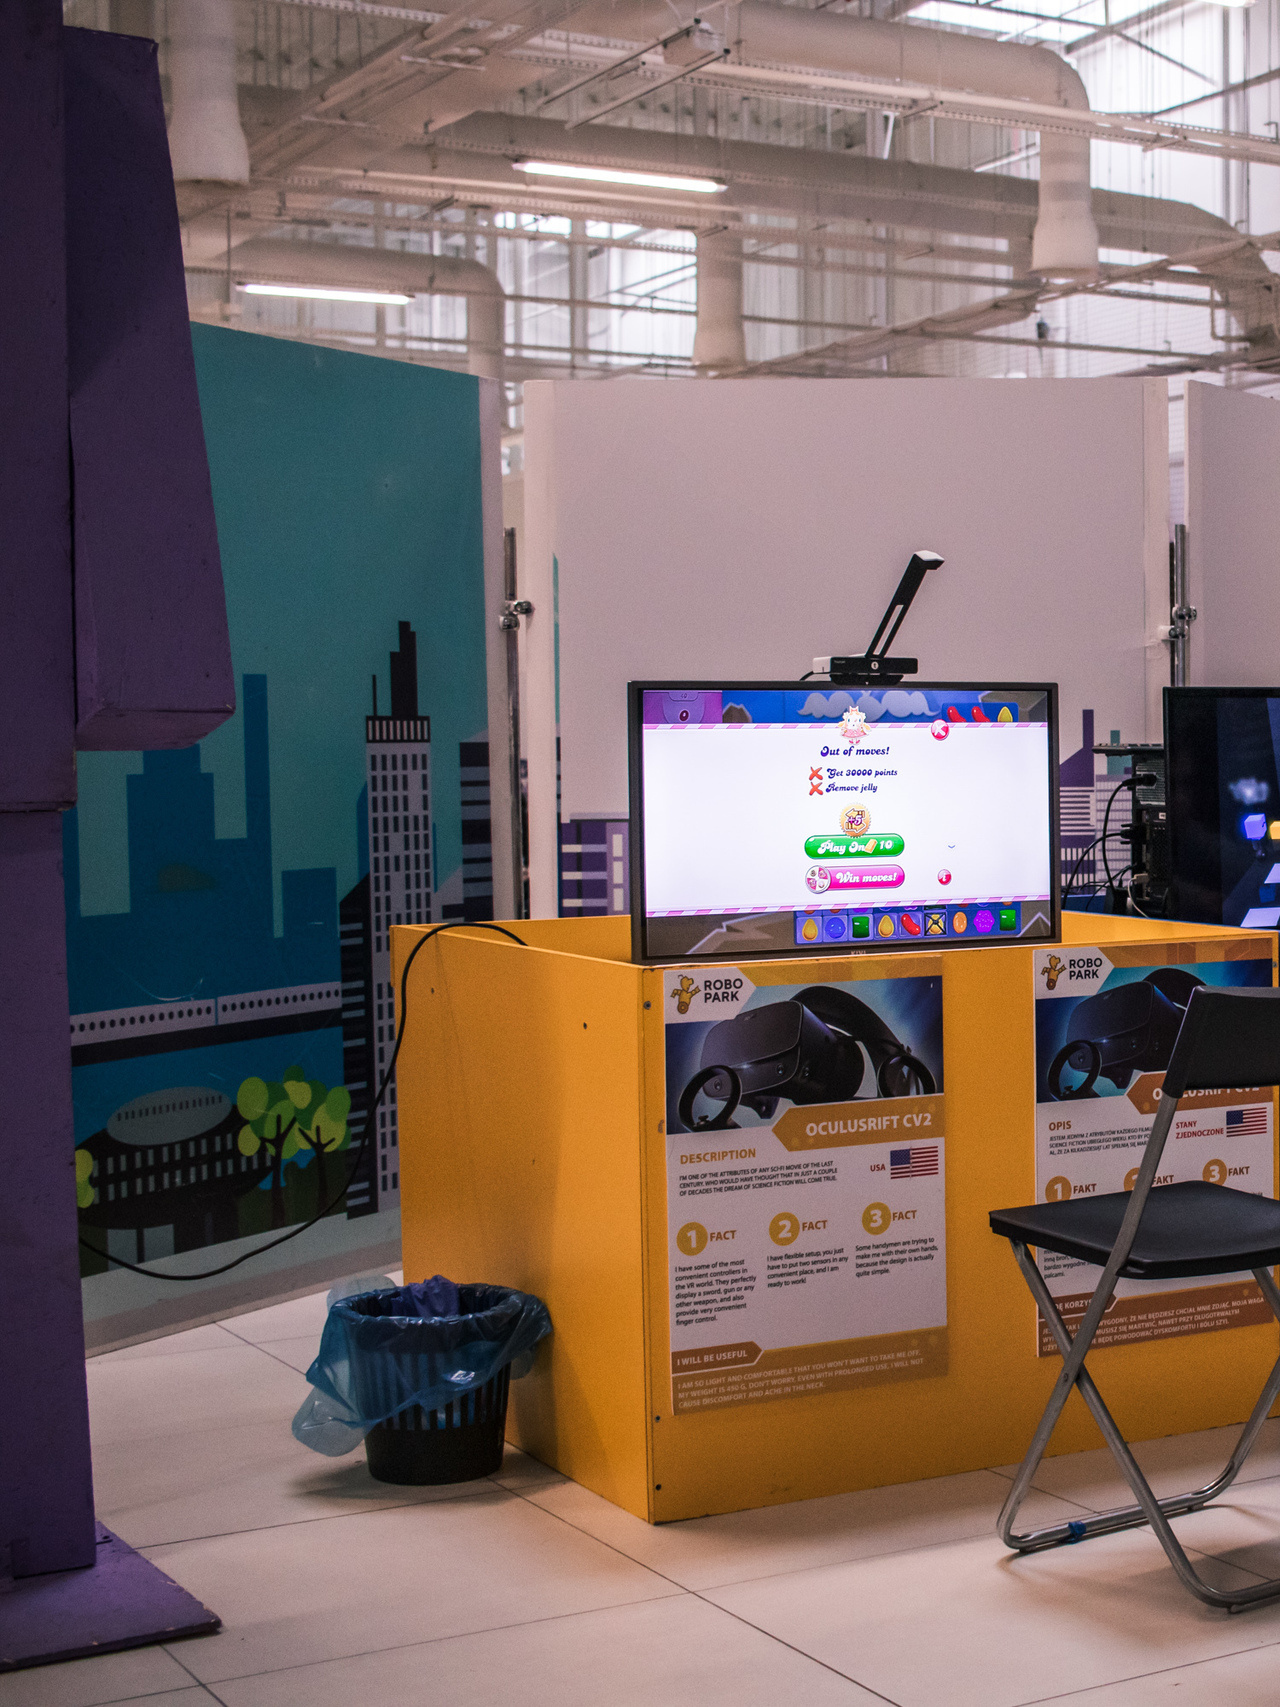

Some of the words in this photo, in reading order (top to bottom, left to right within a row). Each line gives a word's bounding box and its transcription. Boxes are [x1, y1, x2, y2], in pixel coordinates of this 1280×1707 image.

[820, 746, 840, 757] Out
[843, 746, 854, 757] of
[856, 746, 890, 756] moves!
[827, 768, 843, 779] Get
[845, 769, 872, 777] 30000
[874, 768, 898, 778] points
[825, 782, 859, 793] Remove
[860, 783, 878, 793] jelly
[817, 840, 846, 855] Play
[849, 841, 866, 853] On
[879, 840, 893, 850] 10
[835, 871, 860, 884] Win
[862, 872, 897, 883] moves!
[1069, 957, 1103, 969] ROBO
[1069, 968, 1099, 980] PARK
[703, 978, 743, 992] ROBO
[704, 989, 740, 1003] PARK
[806, 1114, 900, 1137] OCULUSRIFT
[903, 1112, 932, 1128] CV2
[1049, 1120, 1072, 1131] OPIS
[1175, 1120, 1197, 1130] STANY
[1175, 1127, 1224, 1140] ZJEDNOCZONE
[679, 1148, 756, 1165] DESCRIPTION
[719, 1168, 749, 1177] ATTRIBUTES
[754, 1173, 779, 1181] THOUGHT
[818, 1167, 837, 1175] COUPLE
[870, 1163, 886, 1173] USA
[1209, 1165, 1220, 1180] 3
[1228, 1166, 1250, 1176] FAKT
[688, 1187, 711, 1195] DECADES
[752, 1181, 772, 1189] SCIENCE
[1073, 1183, 1097, 1195] FAKT
[870, 1209, 883, 1227] 3
[892, 1210, 918, 1221] FACT
[778, 1219, 792, 1238] 2
[801, 1219, 828, 1232] FACT
[688, 1231, 697, 1249] 1
[709, 1229, 737, 1242] FACT
[675, 1272, 708, 1281] convenient
[709, 1268, 740, 1277] controllers
[715, 1278, 728, 1286] They
[730, 1274, 756, 1284] perfectly
[675, 1291, 696, 1299] display
[676, 1308, 698, 1317] provide
[714, 1302, 746, 1312] convenient
[676, 1317, 693, 1326] finger
[681, 1355, 700, 1365] WILL
[703, 1354, 714, 1362] BE
[716, 1349, 747, 1360] USEFUL
